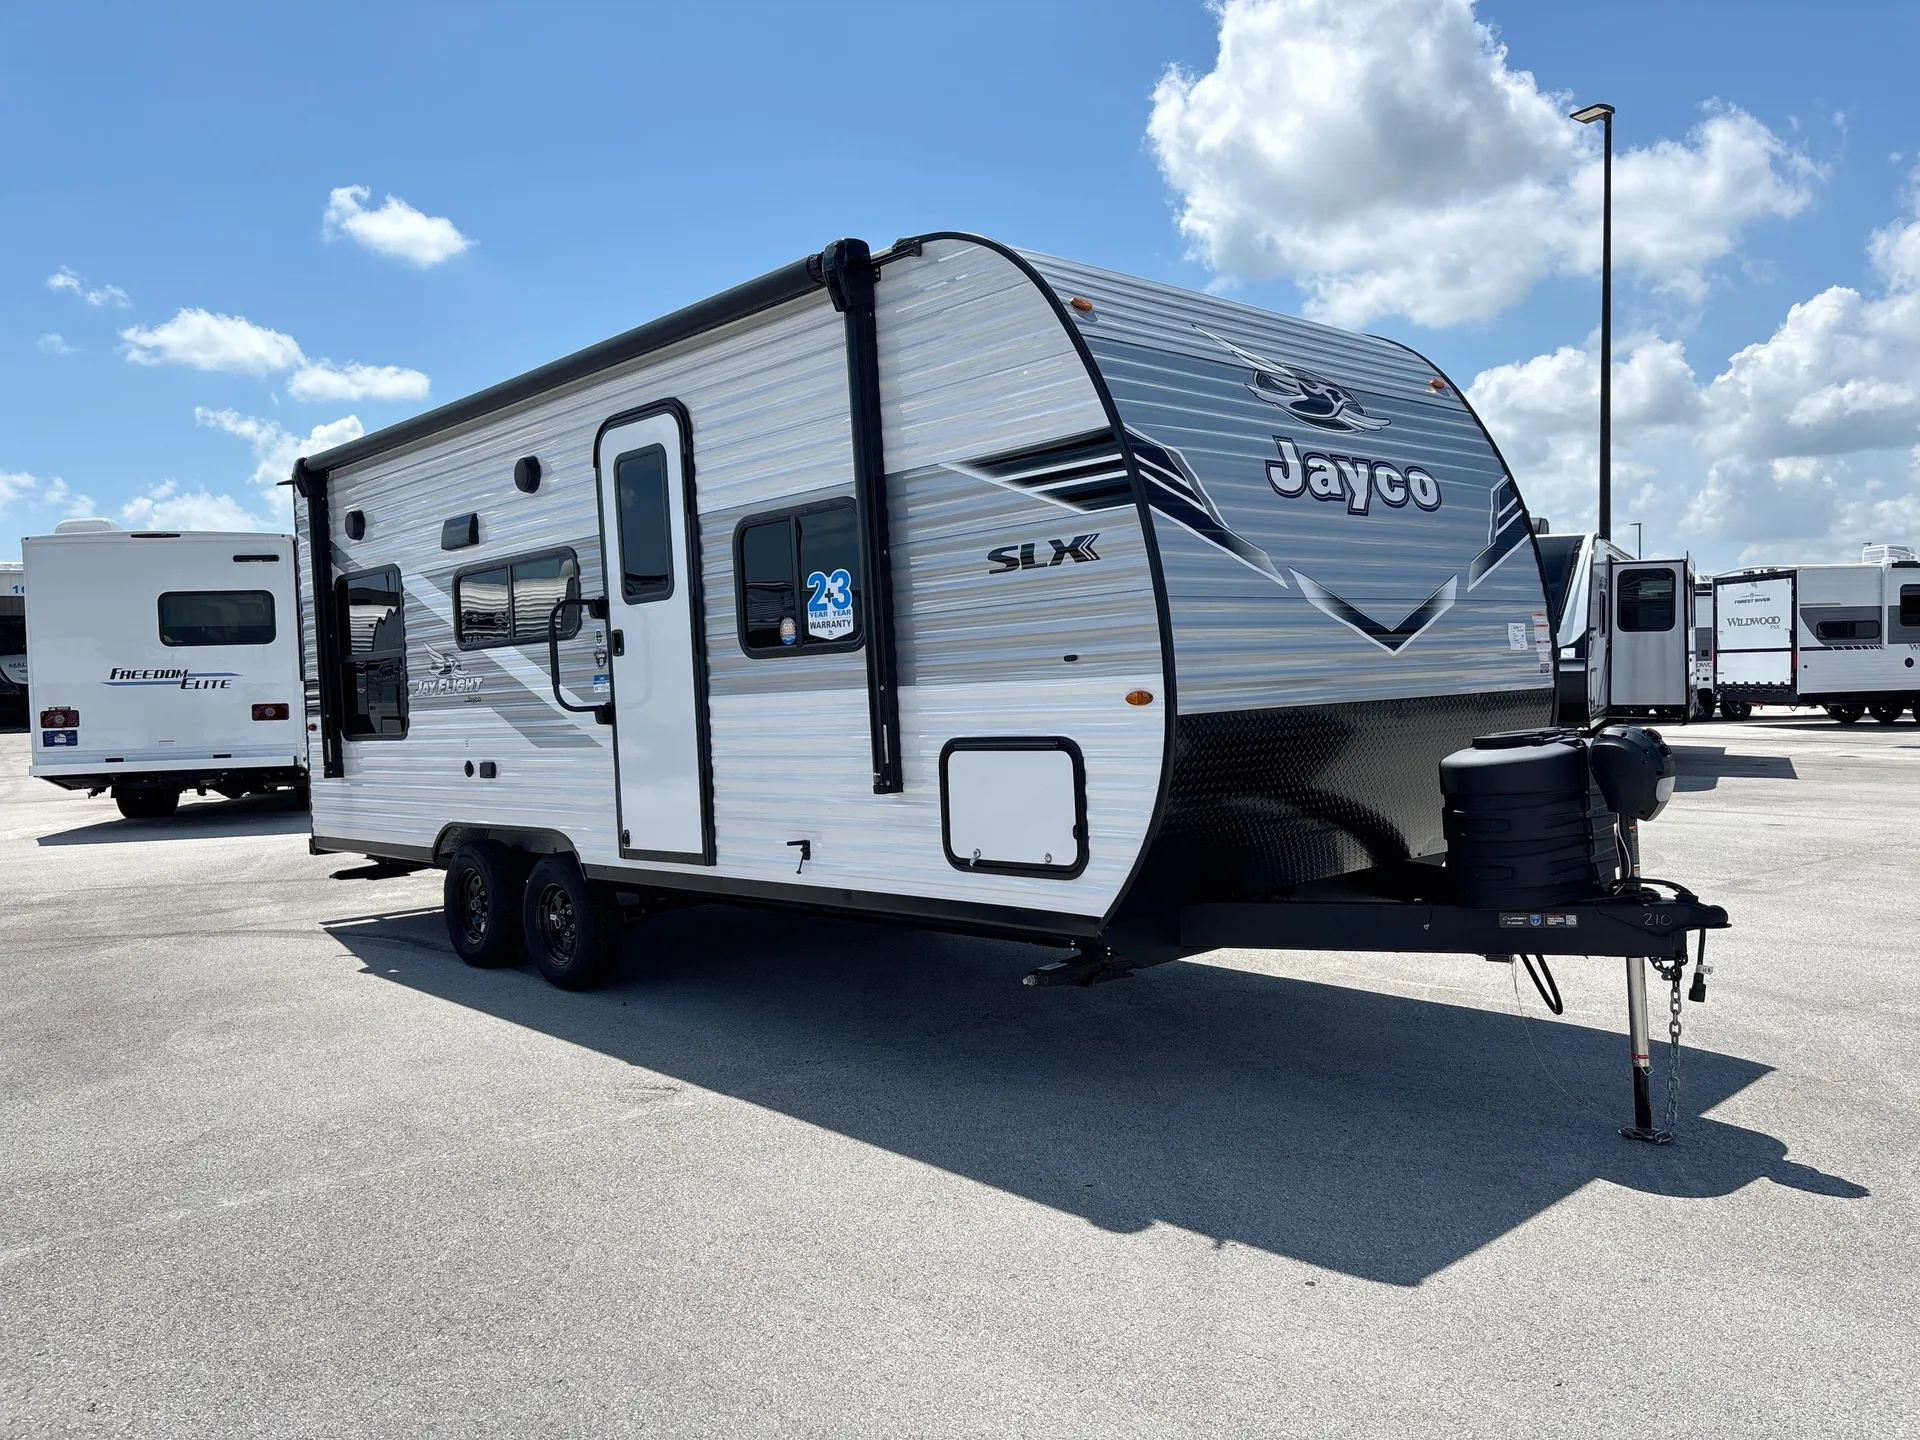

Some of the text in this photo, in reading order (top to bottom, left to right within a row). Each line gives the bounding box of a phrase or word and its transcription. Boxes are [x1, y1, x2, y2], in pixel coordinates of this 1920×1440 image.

[1265, 436, 1442, 516] Jayco
[987, 533, 1101, 574] SLX
[809, 609, 852, 619] YEAR YEAR
[809, 619, 852, 630] WARRANTY
[1727, 615, 1781, 627] WILDWOOD
[109, 667, 188, 680] FREEDOM
[180, 678, 232, 690] ELITE
[413, 676, 485, 697] JAY FLIGHT
[1643, 912, 1673, 926] 210
